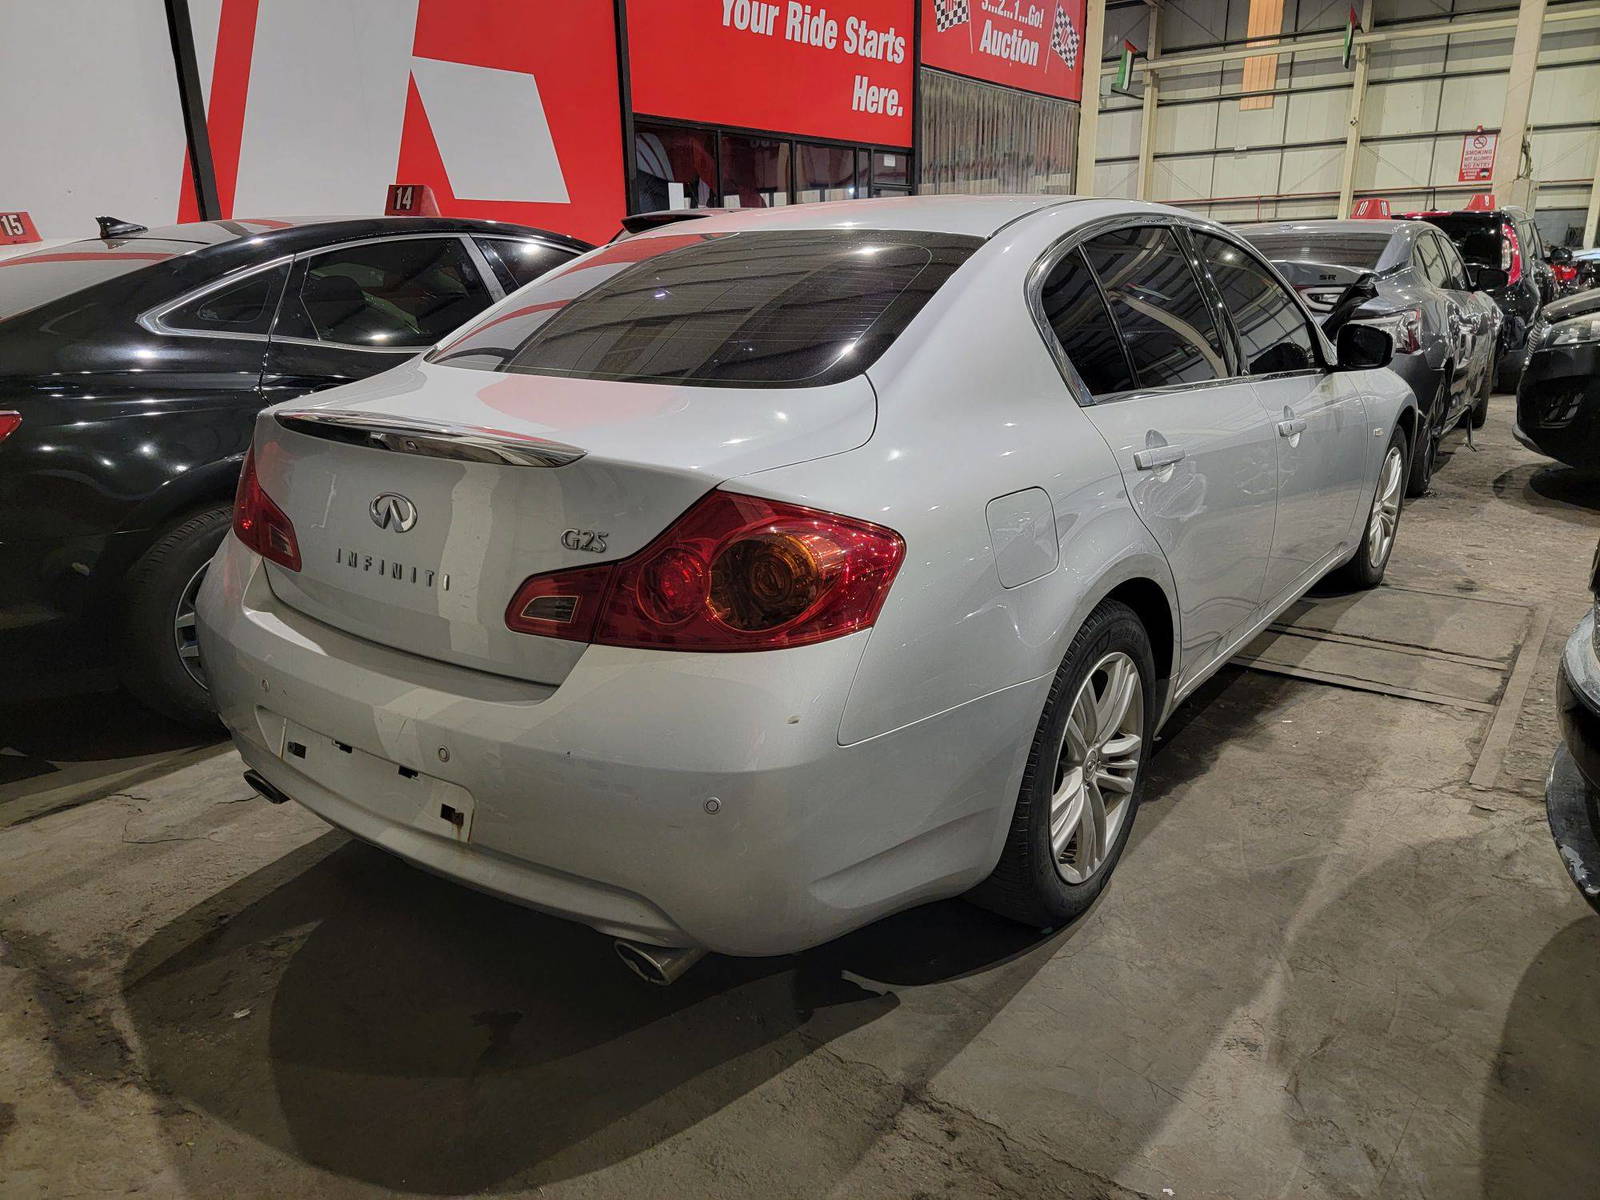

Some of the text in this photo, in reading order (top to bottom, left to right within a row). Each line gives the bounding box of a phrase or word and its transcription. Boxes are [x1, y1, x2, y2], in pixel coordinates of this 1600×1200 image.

[722, 0, 906, 64] Your Ride Starts
[979, 19, 1040, 67] Auction
[852, 75, 904, 117] Here.
[396, 186, 412, 210] 14
[1356, 200, 1369, 217] 10
[0, 214, 24, 236] 15
[560, 527, 609, 553] G25
[336, 547, 450, 591] INFINITI
